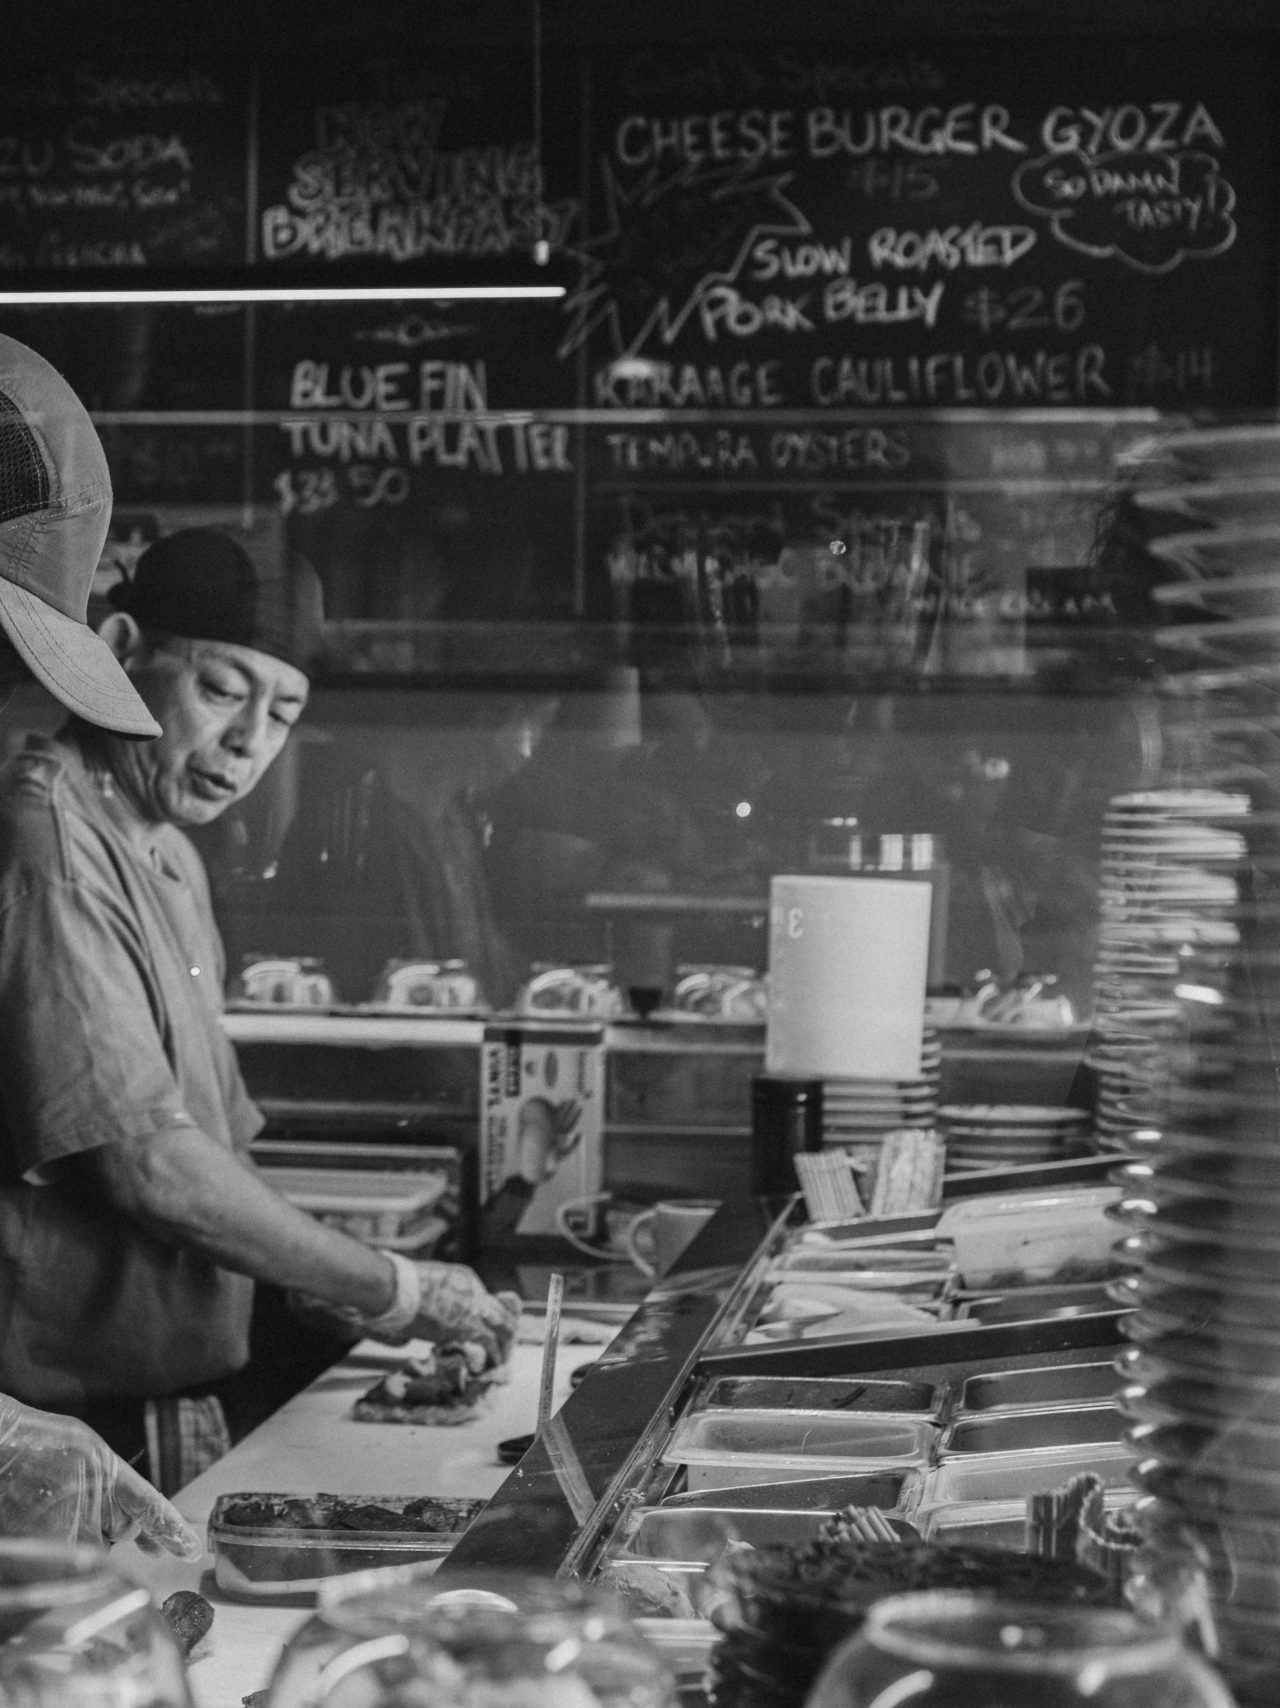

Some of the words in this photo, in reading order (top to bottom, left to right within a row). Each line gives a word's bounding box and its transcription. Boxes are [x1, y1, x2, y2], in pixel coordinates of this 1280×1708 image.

[1039, 102, 1225, 155] GYOZA
[748, 236, 853, 282] SLOW
[866, 220, 1038, 274] ROASTED
[696, 284, 817, 342] PORK
[822, 275, 946, 331] BELLY
[289, 358, 413, 412] BLUE
[418, 357, 491, 414] FIN
[809, 342, 1114, 407] CAULIFLOWER
[279, 416, 402, 464] TUNA
[768, 427, 912, 472] OYSTERS
